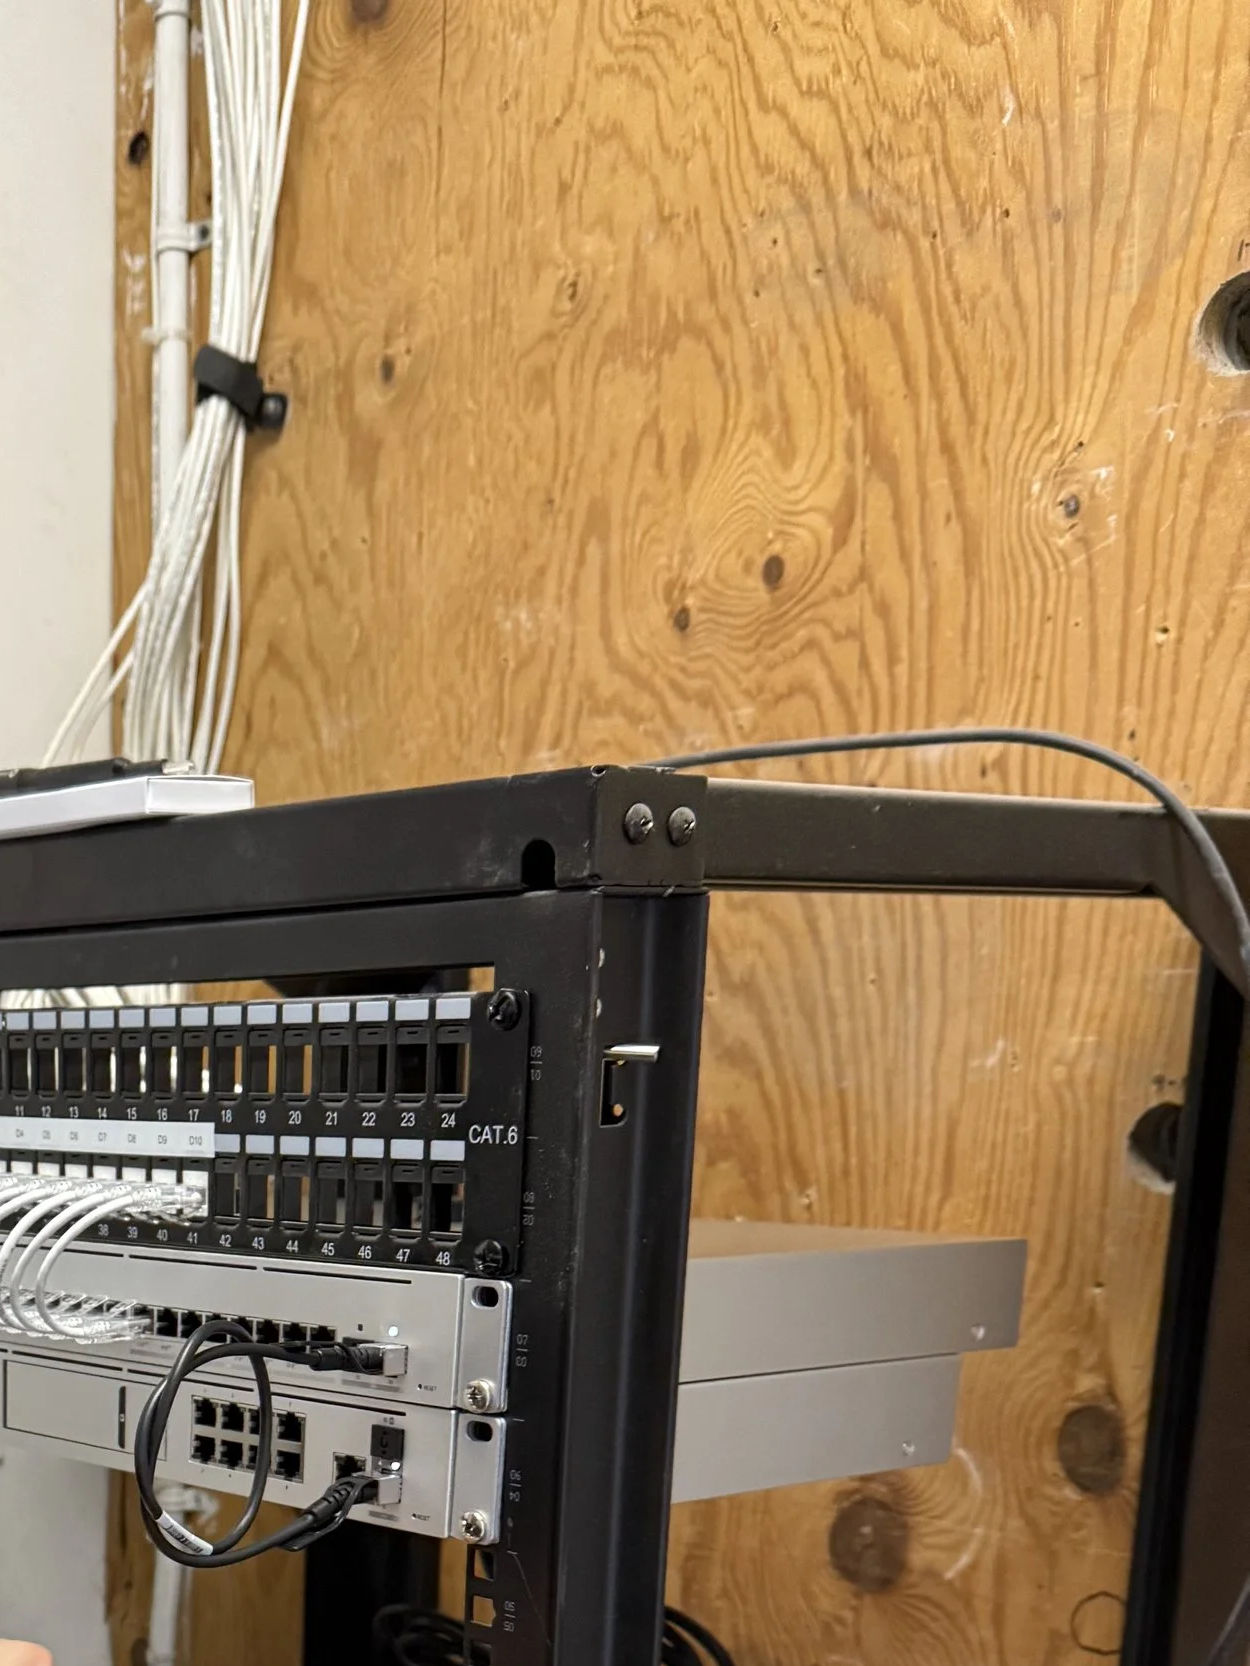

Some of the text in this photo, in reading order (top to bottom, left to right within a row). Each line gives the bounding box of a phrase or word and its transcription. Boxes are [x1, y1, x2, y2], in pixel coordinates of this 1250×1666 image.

[15, 1105, 24, 1117] 11
[42, 1105, 51, 1118] 12
[69, 1106, 78, 1118] 13
[97, 1107, 107, 1119] 14
[127, 1107, 137, 1120] 15
[157, 1108, 168, 1120] 16
[188, 1108, 200, 1121] 17
[221, 1109, 232, 1122] 18
[255, 1110, 266, 1123] 19
[288, 1110, 301, 1124] 20
[325, 1111, 338, 1125] 21
[361, 1112, 376, 1126] 22
[400, 1112, 415, 1127] 23
[441, 1112, 456, 1128] 24
[98, 1132, 107, 1142] D7
[158, 1135, 167, 1144] D9
[189, 1135, 203, 1146] D10
[468, 1124, 518, 1145] CAT.6
[98, 1223, 109, 1236] 38
[127, 1226, 138, 1239] 39
[157, 1229, 168, 1241] 40
[187, 1231, 198, 1244] 41
[219, 1234, 231, 1247] 42
[252, 1237, 264, 1250] 43
[286, 1240, 298, 1252] 44
[321, 1242, 334, 1256] 45
[358, 1245, 371, 1259] 46
[396, 1249, 410, 1262] 47
[435, 1251, 450, 1265] 48
